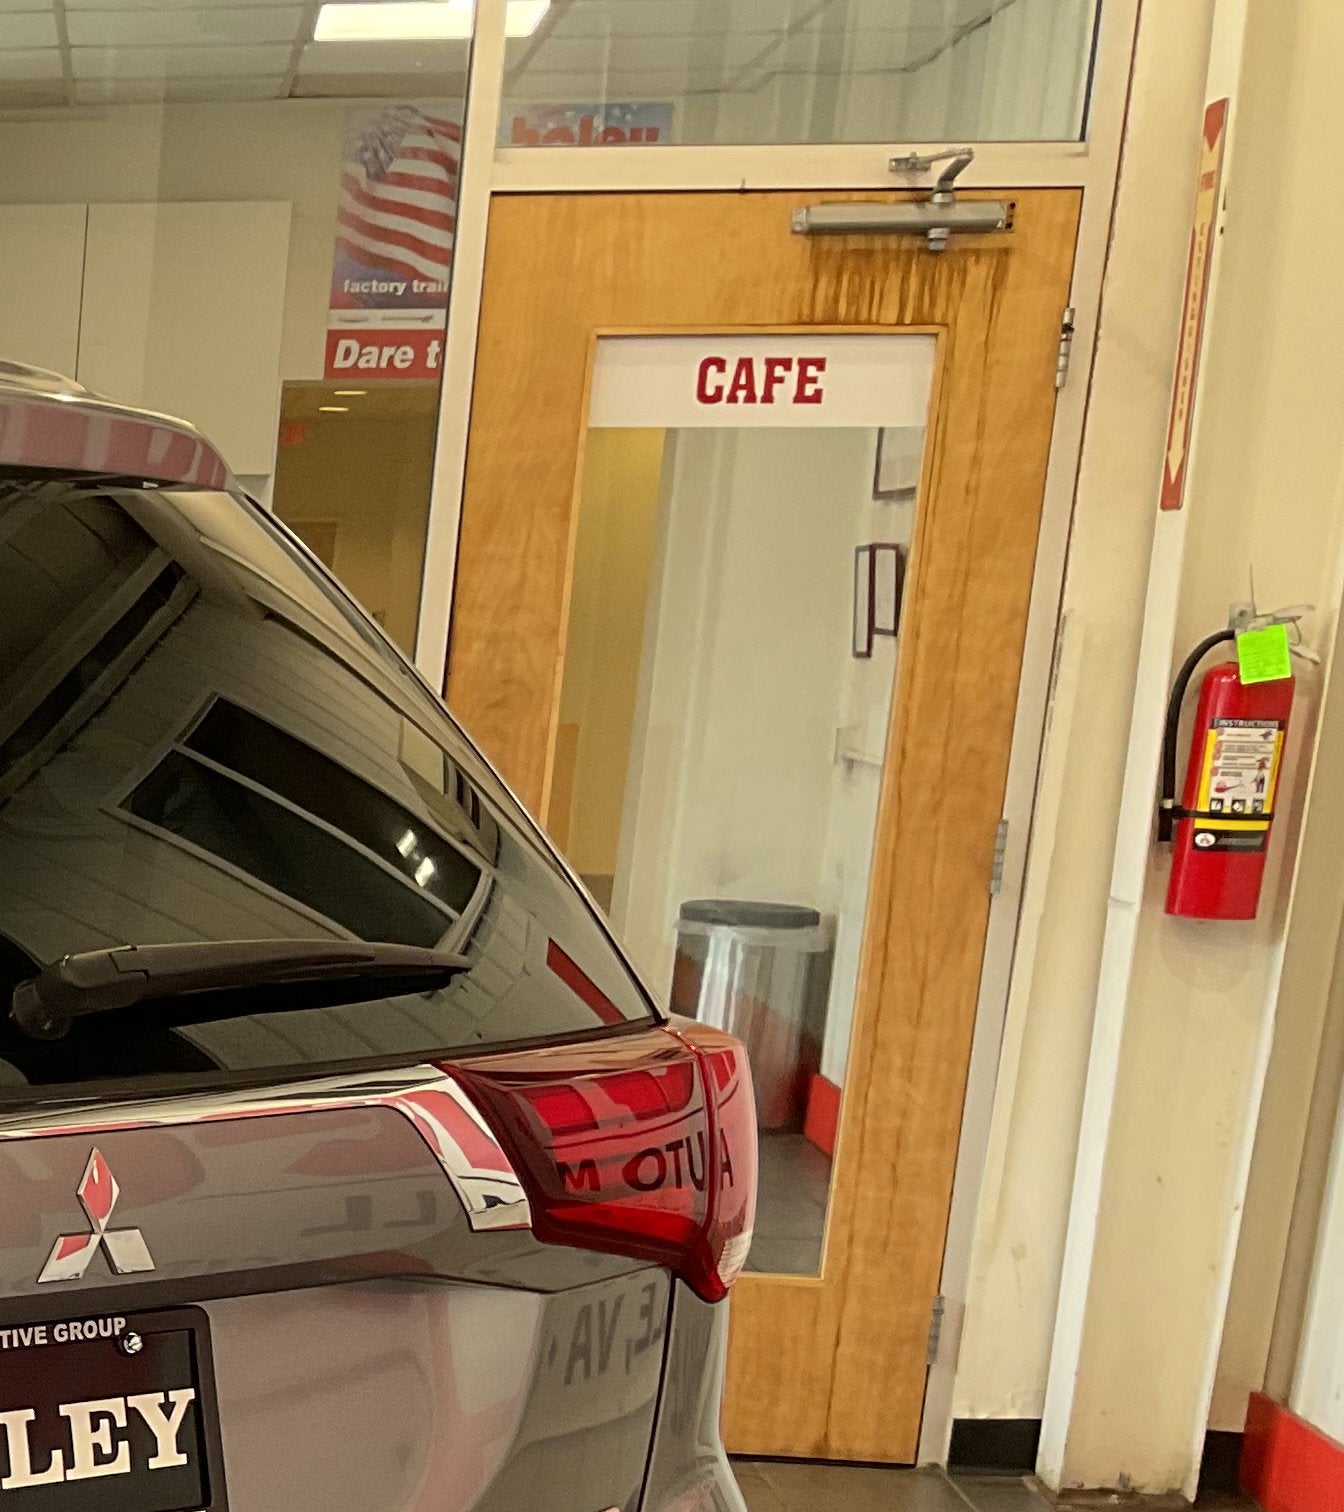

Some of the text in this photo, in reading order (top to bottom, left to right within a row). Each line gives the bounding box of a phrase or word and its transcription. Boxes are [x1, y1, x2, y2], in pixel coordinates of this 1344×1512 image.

[343, 279, 407, 296] factory
[333, 338, 442, 369] Dare t
[696, 356, 827, 404] CAFE
[53, 1316, 127, 1342] GROUP
